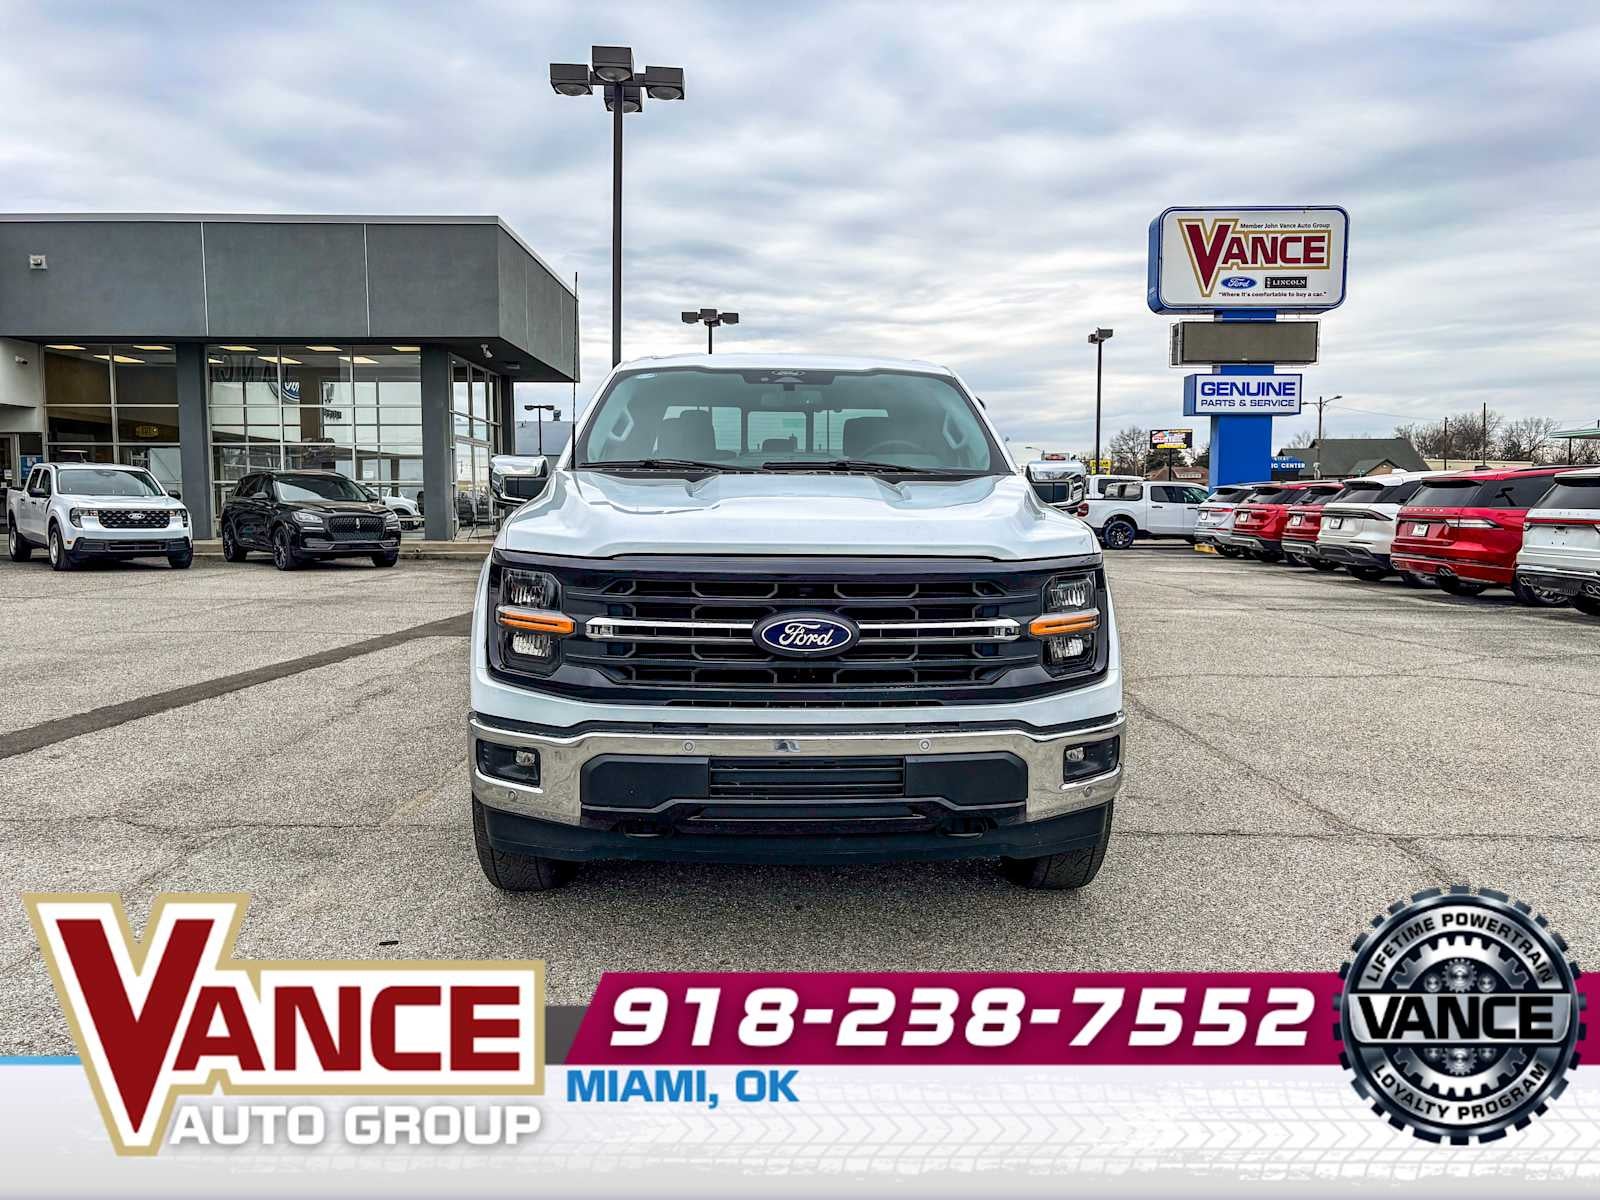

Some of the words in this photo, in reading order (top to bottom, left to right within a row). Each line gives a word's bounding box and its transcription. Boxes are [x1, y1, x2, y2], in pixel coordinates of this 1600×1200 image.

[1184, 224, 1326, 291] VANCE
[1227, 278, 1250, 287] Ford
[1200, 381, 1296, 397] GENUINE
[1200, 399, 1235, 407] PARTS
[1239, 399, 1247, 407] &
[1250, 399, 1295, 407] SERVICE
[778, 622, 834, 646] Ford
